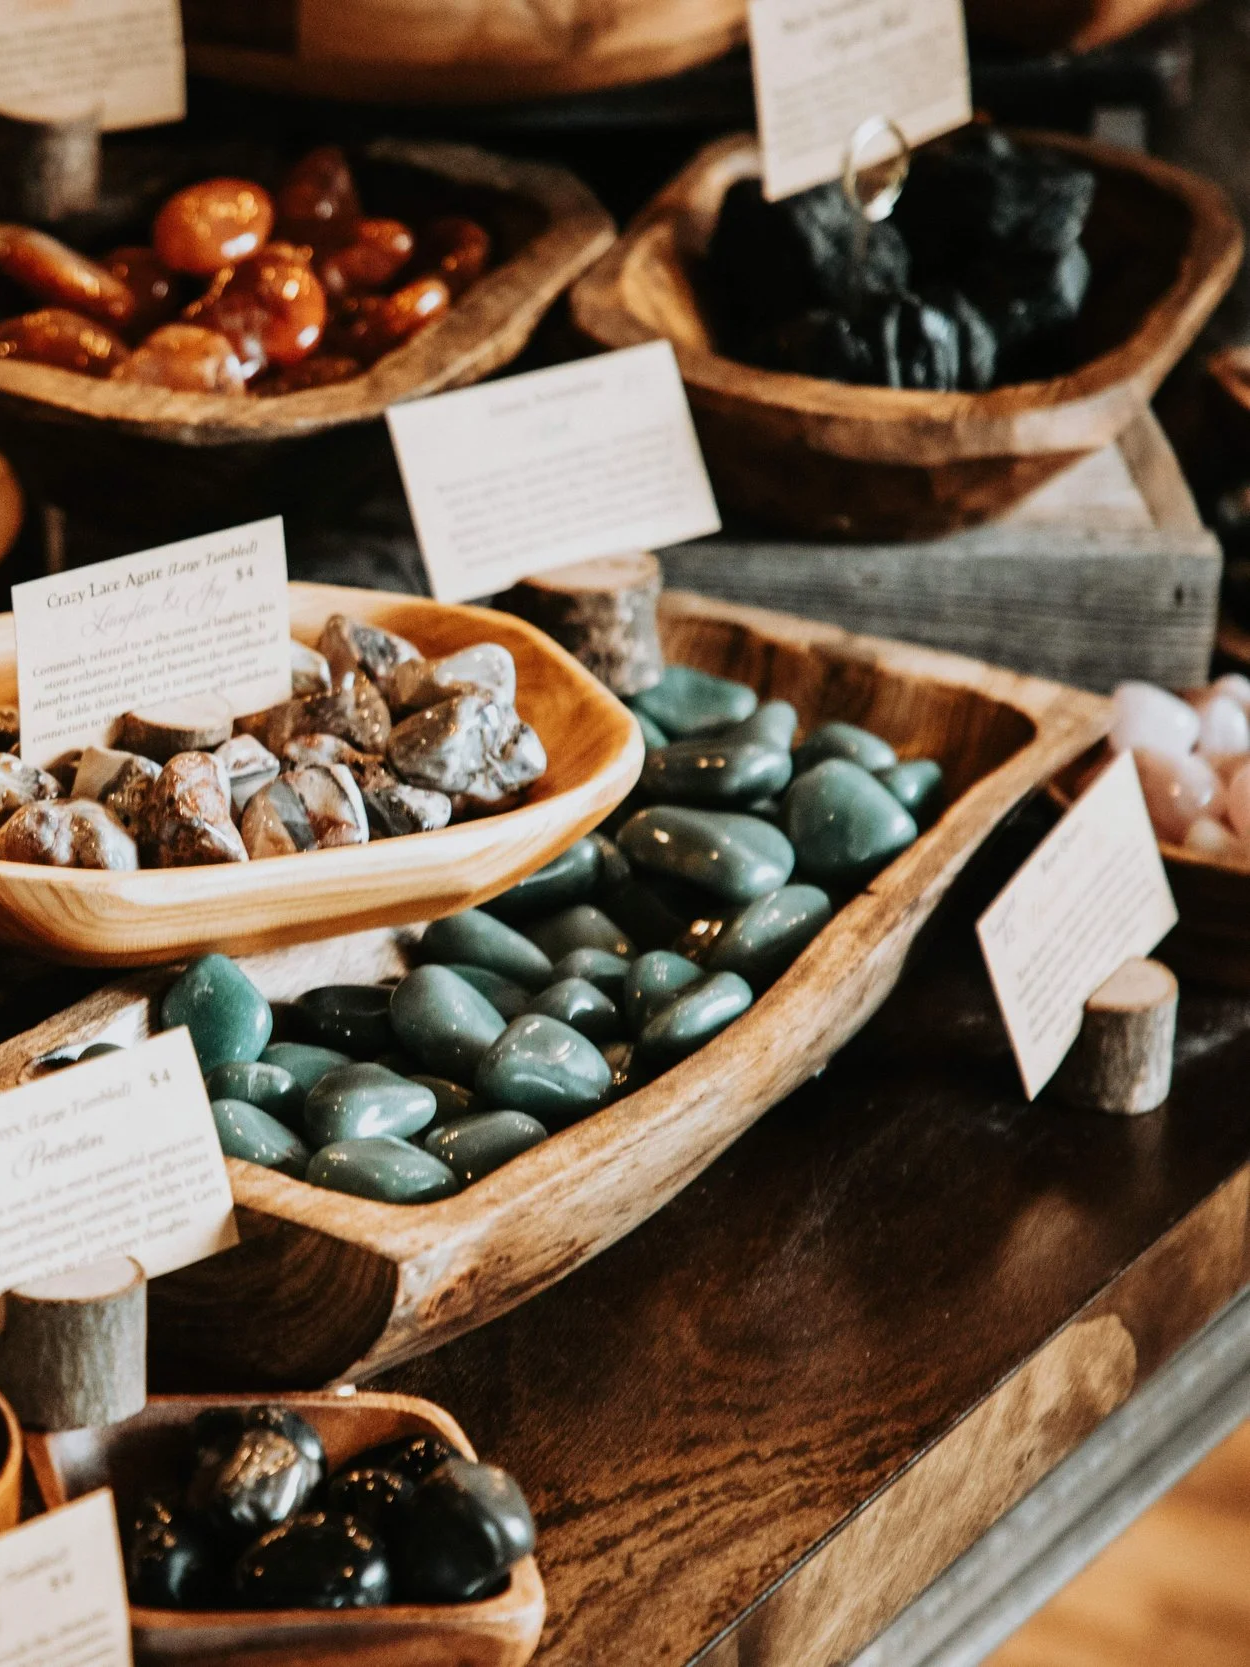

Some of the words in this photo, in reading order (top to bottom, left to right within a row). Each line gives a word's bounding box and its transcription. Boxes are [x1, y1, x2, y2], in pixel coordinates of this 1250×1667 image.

[45, 589, 86, 609] Crazy
[88, 579, 120, 598] Lace
[124, 567, 163, 589] Agate
[31, 653, 86, 678] Commonly
[10, 1133, 105, 1179] Protection
